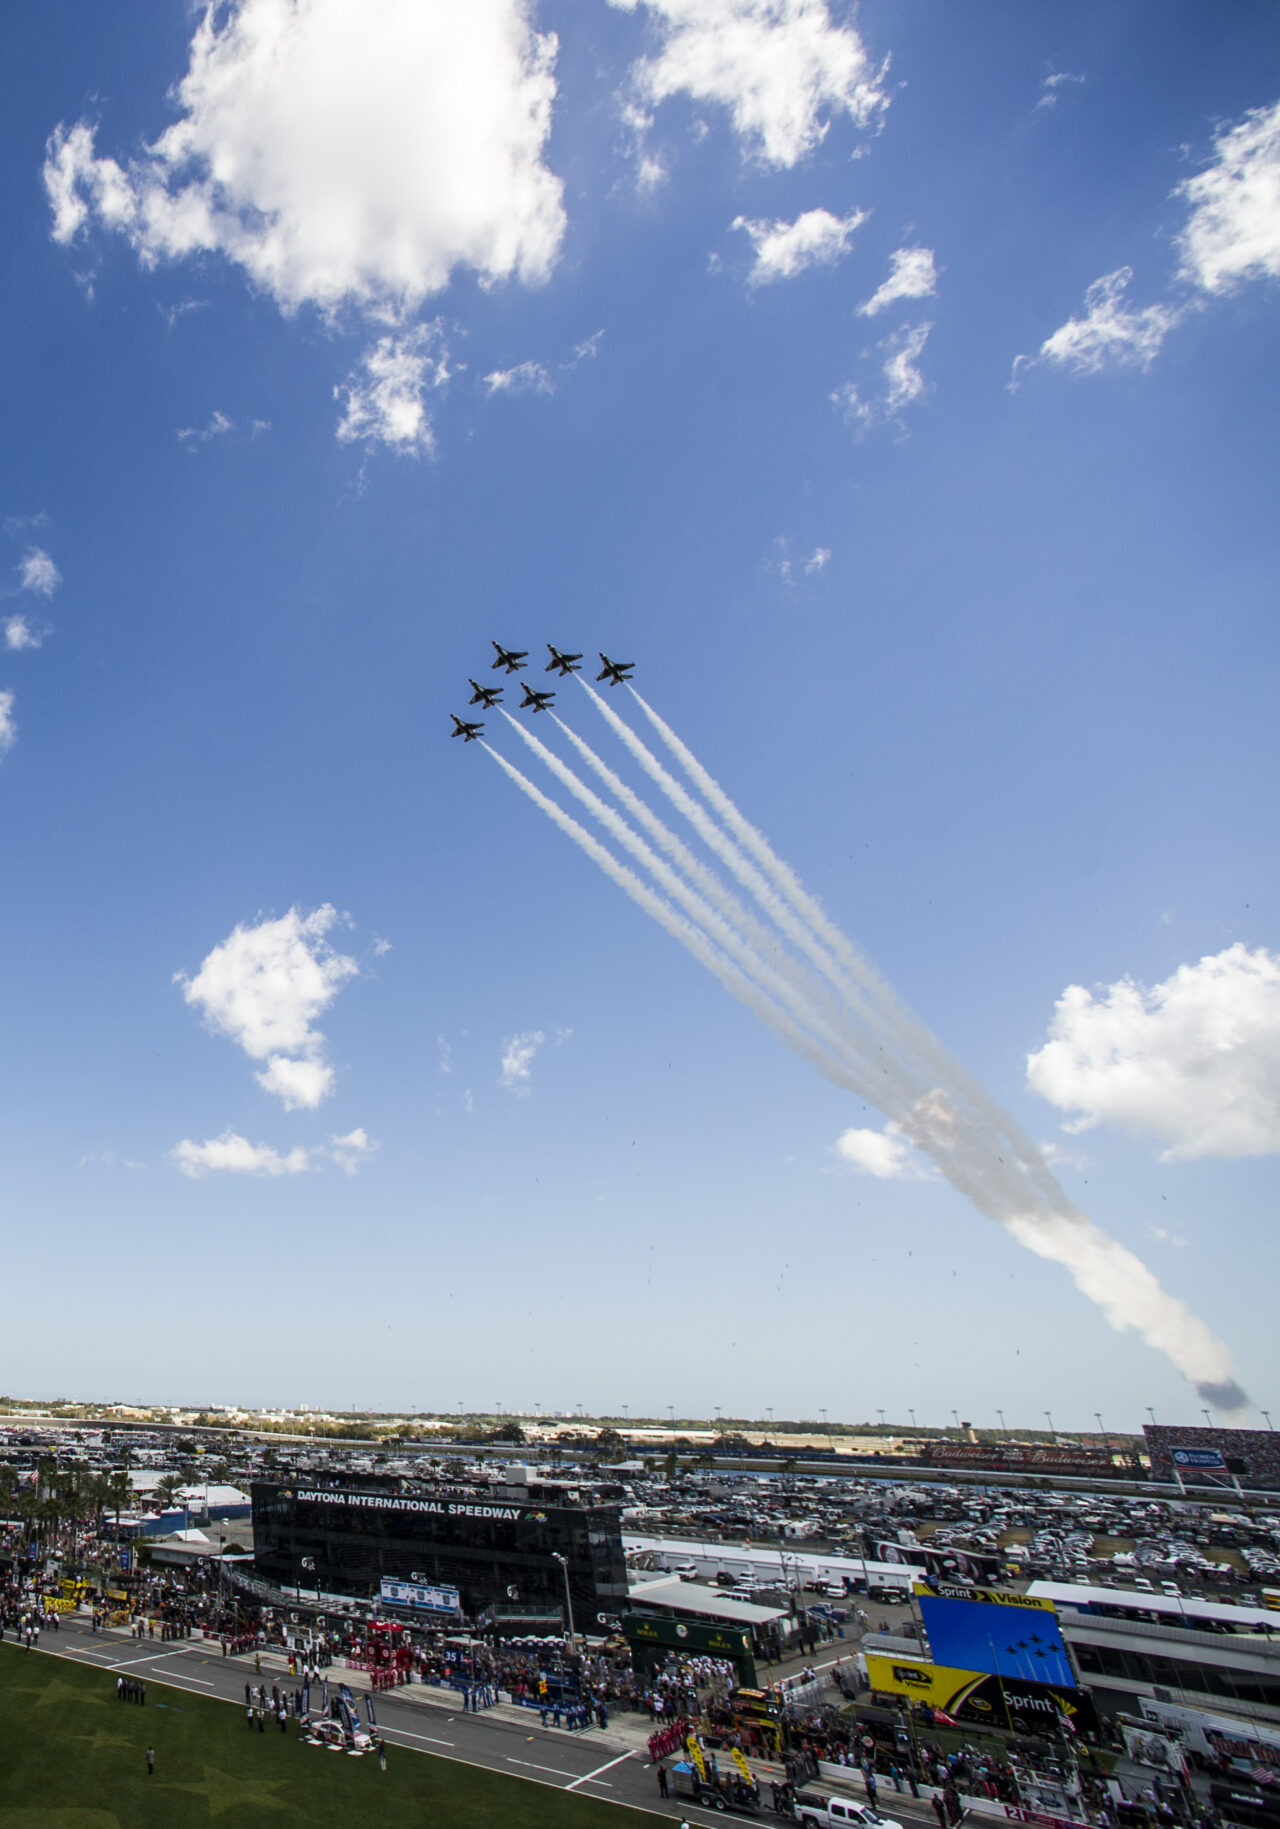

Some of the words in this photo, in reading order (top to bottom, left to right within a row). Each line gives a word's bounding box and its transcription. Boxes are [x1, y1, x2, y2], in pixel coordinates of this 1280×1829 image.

[929, 1447, 998, 1460] Budweiser
[1027, 1452, 1106, 1466] Budweiser
[297, 1490, 346, 1505] DAYTONA
[348, 1496, 445, 1513] INTERNATIONAL
[448, 1504, 521, 1520] SPEEDWAY
[937, 1585, 972, 1599] Sprint
[997, 1593, 1042, 1607] Vision
[636, 1629, 658, 1638] ROLEX
[708, 1640, 732, 1649] ROLEX
[445, 1651, 457, 1662] 35
[1003, 1690, 1054, 1713] Sprint
[1008, 1808, 1026, 1821] 21
